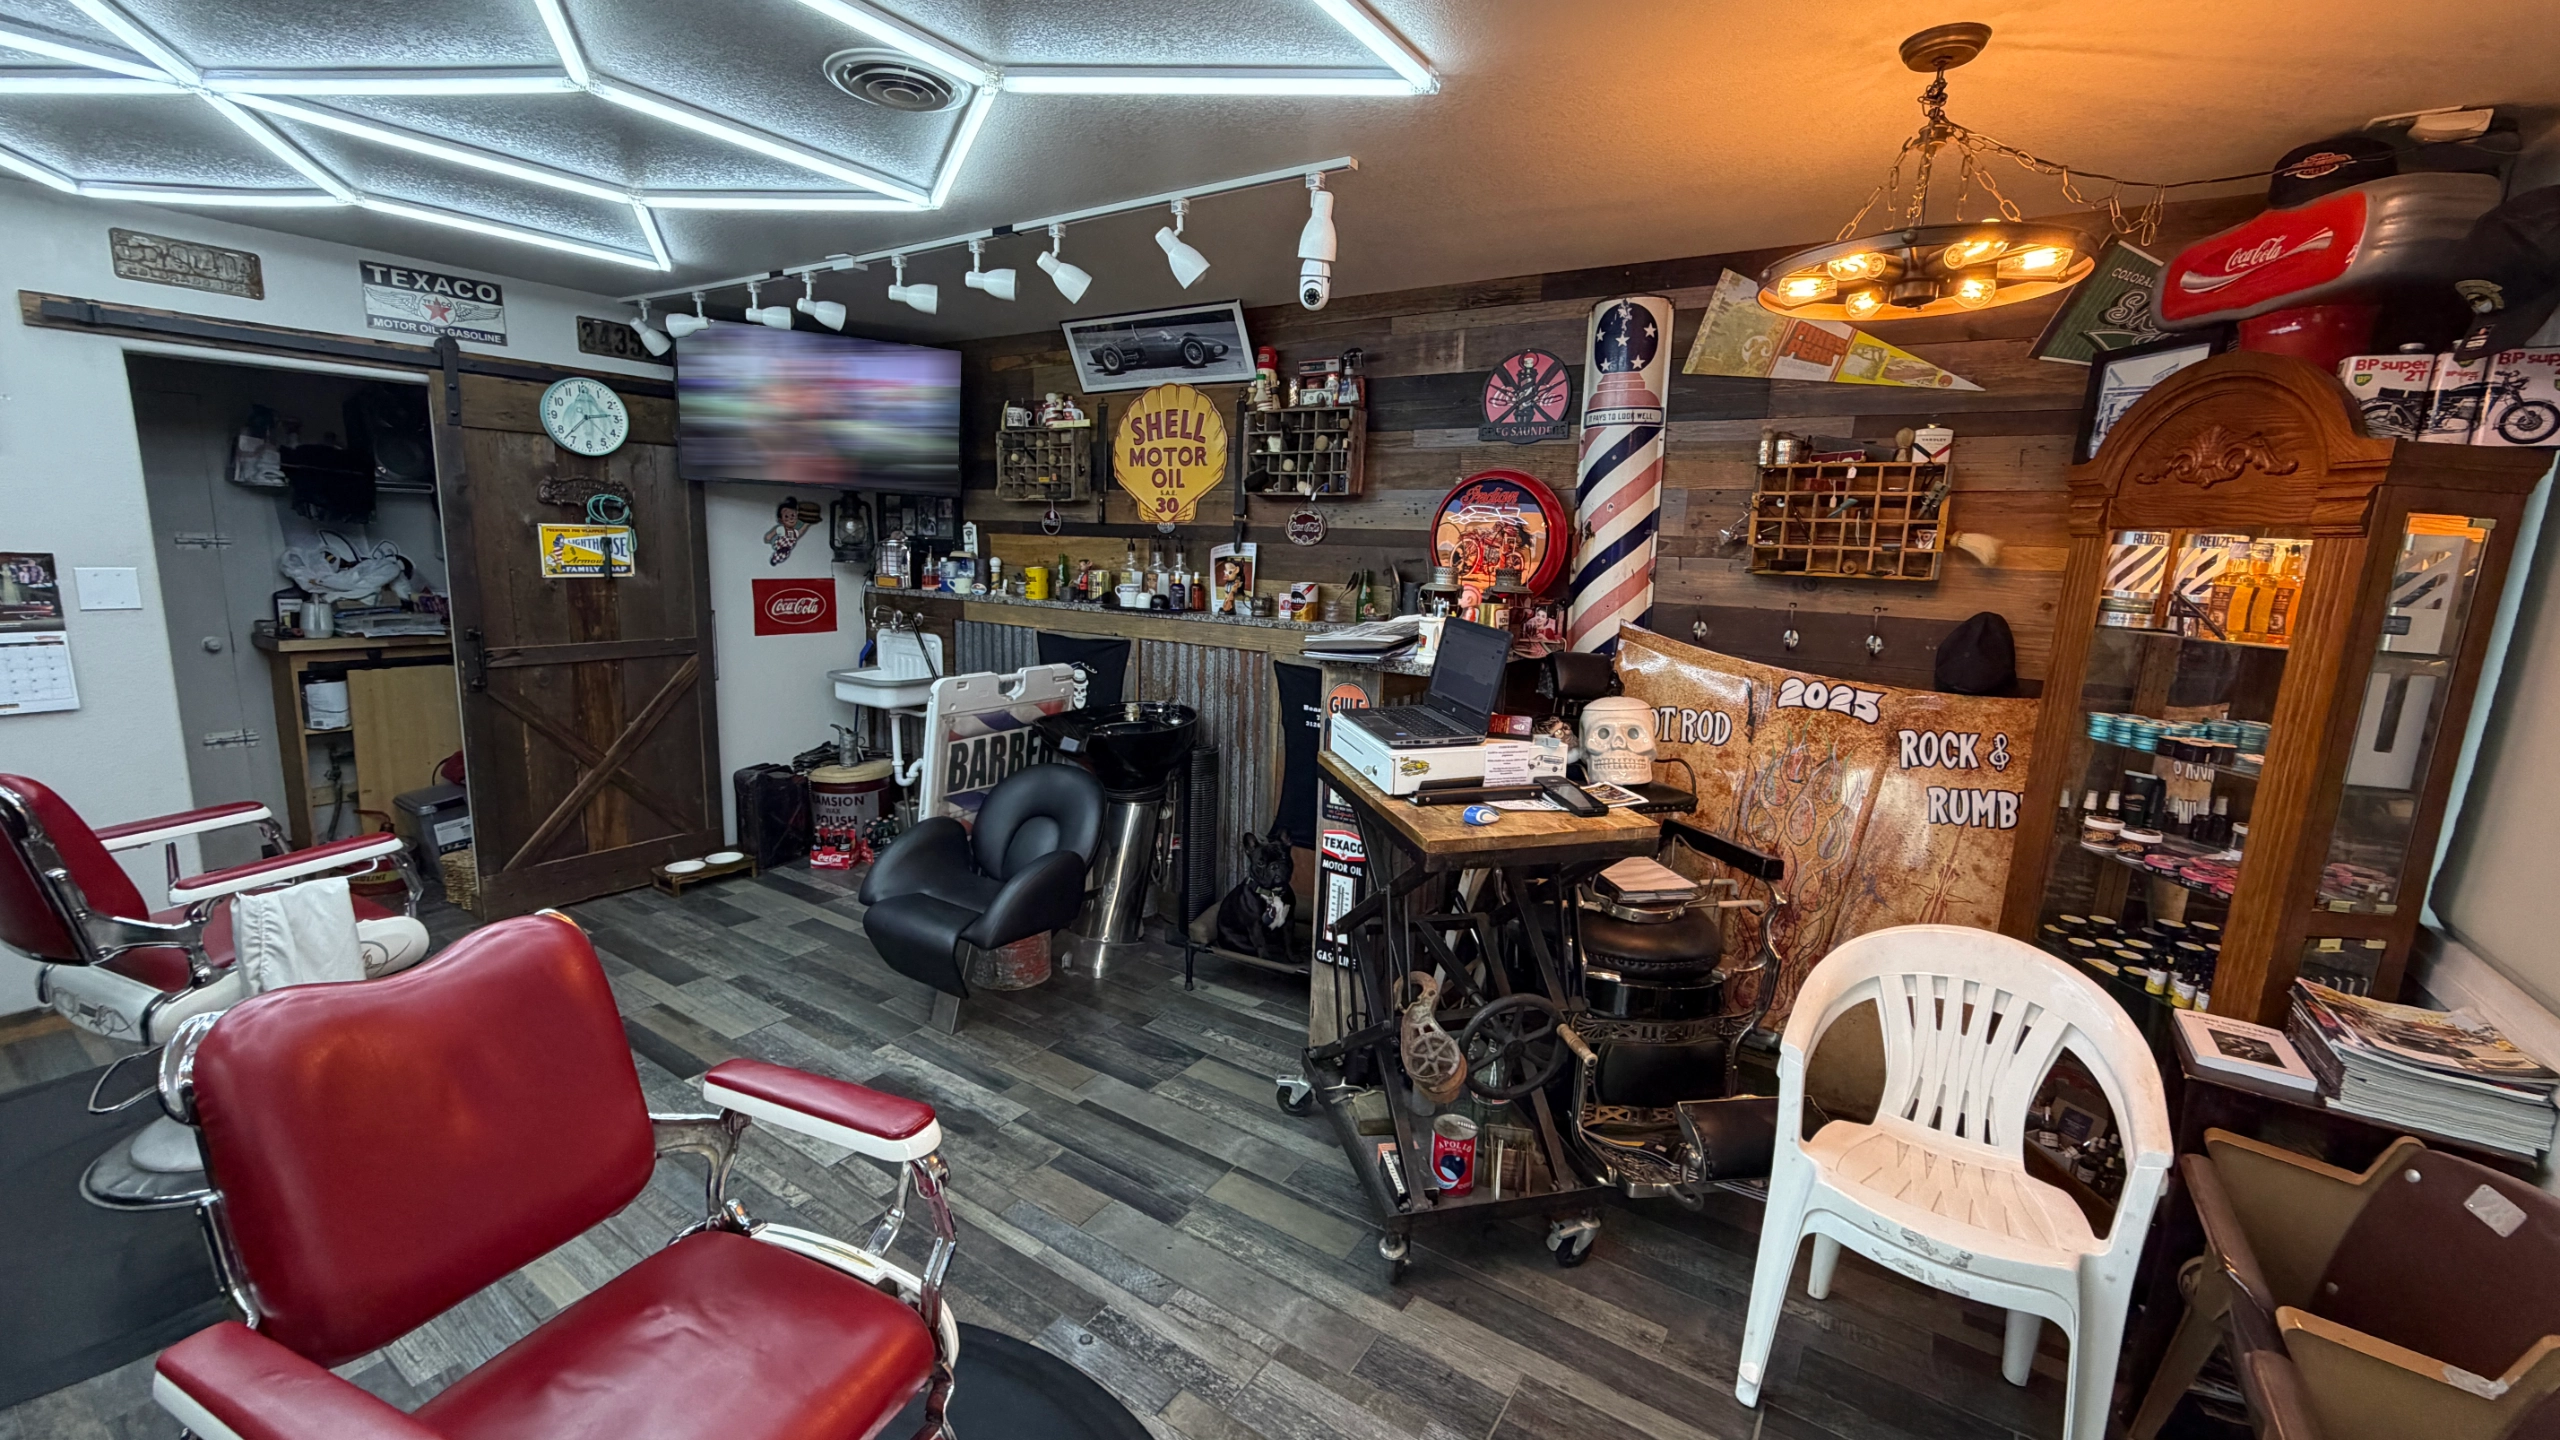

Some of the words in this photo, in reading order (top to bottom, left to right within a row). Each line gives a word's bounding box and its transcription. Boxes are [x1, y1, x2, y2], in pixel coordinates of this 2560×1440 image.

[366, 264, 497, 302] TEXACO
[373, 317, 417, 332] MOTOR
[420, 324, 439, 335] OIL
[447, 327, 502, 344] GASOLINE
[2355, 358, 2380, 371] BP
[2380, 360, 2430, 374] super
[2498, 352, 2525, 365] BP
[2527, 354, 2560, 369] sup
[2356, 375, 2371, 384] BP
[2404, 370, 2428, 382] 2T
[565, 387, 572, 397] 11
[554, 397, 564, 407] 10
[607, 401, 614, 410] 2
[551, 411, 558, 419] 9
[613, 415, 620, 424] 3
[1618, 412, 1635, 420] LOOK
[1637, 412, 1653, 420] WELL
[557, 425, 565, 434] 8
[610, 429, 617, 438] 4
[1131, 409, 1206, 446] SHELL
[1510, 425, 1566, 437] SAUNDERS
[570, 435, 577, 444] 7
[586, 440, 593, 450] 6
[600, 438, 607, 447] 5
[1129, 446, 1208, 467] MOTOR
[1151, 468, 1185, 489] OIL
[1460, 484, 1520, 505] Indian
[1155, 497, 1179, 513] 30
[2133, 533, 2165, 545] REUZEL
[771, 597, 819, 616] Coca-Cola
[1776, 676, 1887, 725] 2025
[1679, 708, 1732, 747] ROD
[1897, 728, 1981, 770] ROCK
[1926, 786, 2022, 830] RUMB
[1324, 836, 1365, 855] TEXACO
[1322, 859, 1348, 873] MOTOR
[1350, 865, 1363, 877] OIL
[1438, 1140, 1472, 1153] APOLLO
